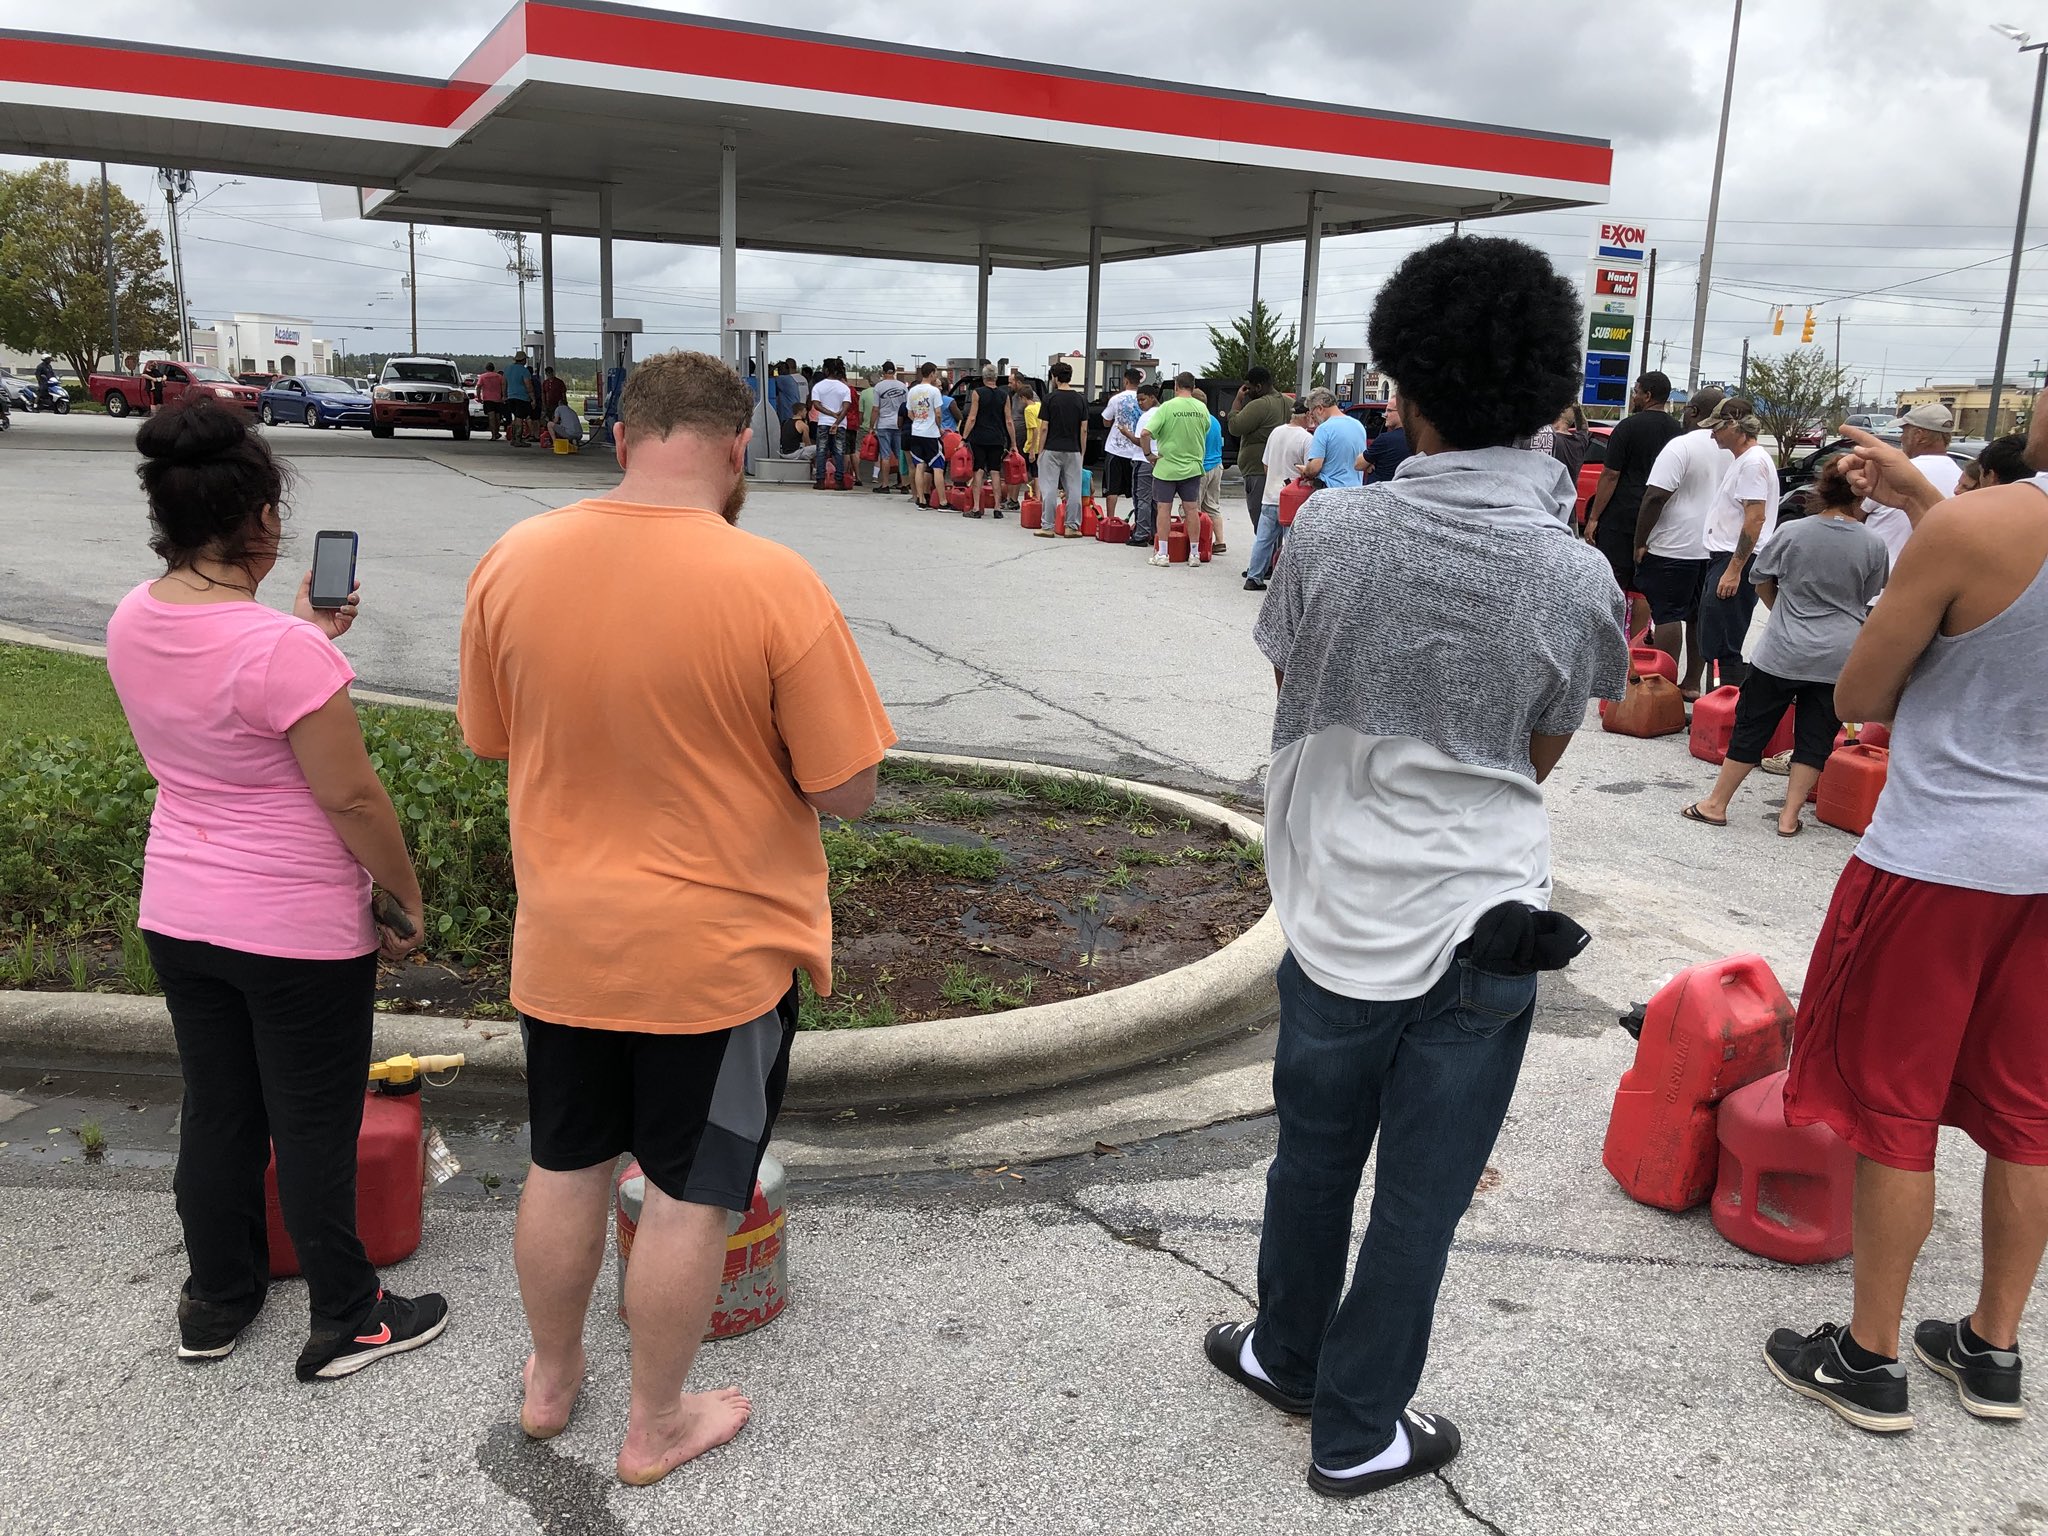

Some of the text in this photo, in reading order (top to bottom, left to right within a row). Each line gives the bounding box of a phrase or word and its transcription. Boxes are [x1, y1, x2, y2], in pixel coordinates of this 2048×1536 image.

[1601, 224, 1646, 248] EXXON
[1607, 271, 1635, 285] Handy
[1613, 284, 1635, 295] Mart
[274, 326, 300, 341] Academy
[1591, 326, 1632, 340] SUBWAY
[1665, 1032, 1691, 1105] GASOLINE
